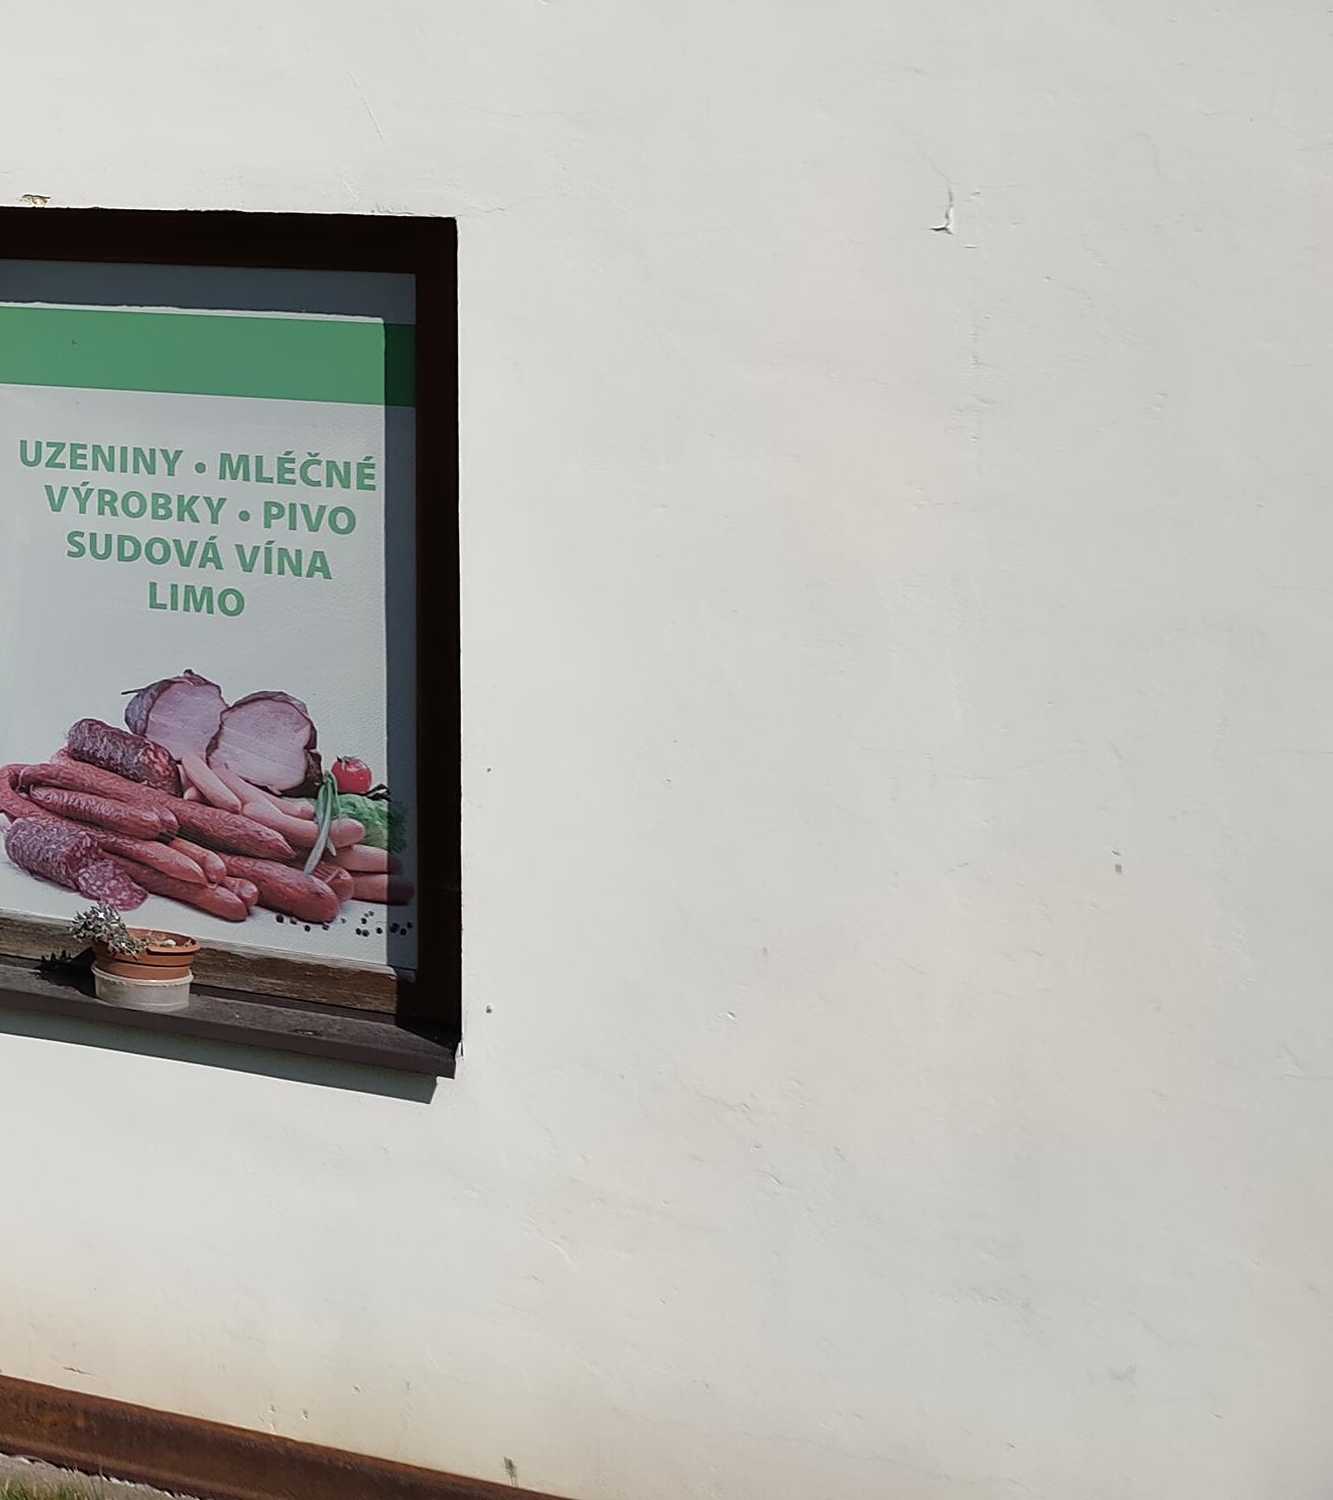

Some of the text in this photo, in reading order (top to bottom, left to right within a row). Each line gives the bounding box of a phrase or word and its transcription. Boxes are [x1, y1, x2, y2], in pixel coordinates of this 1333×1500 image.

[19, 439, 377, 492] UZENINY MLÉČNÉ
[44, 481, 357, 536] VÝROBKY PIVO
[66, 531, 333, 581] SUDOVÁ VÍNA
[148, 581, 245, 617] LIMO
